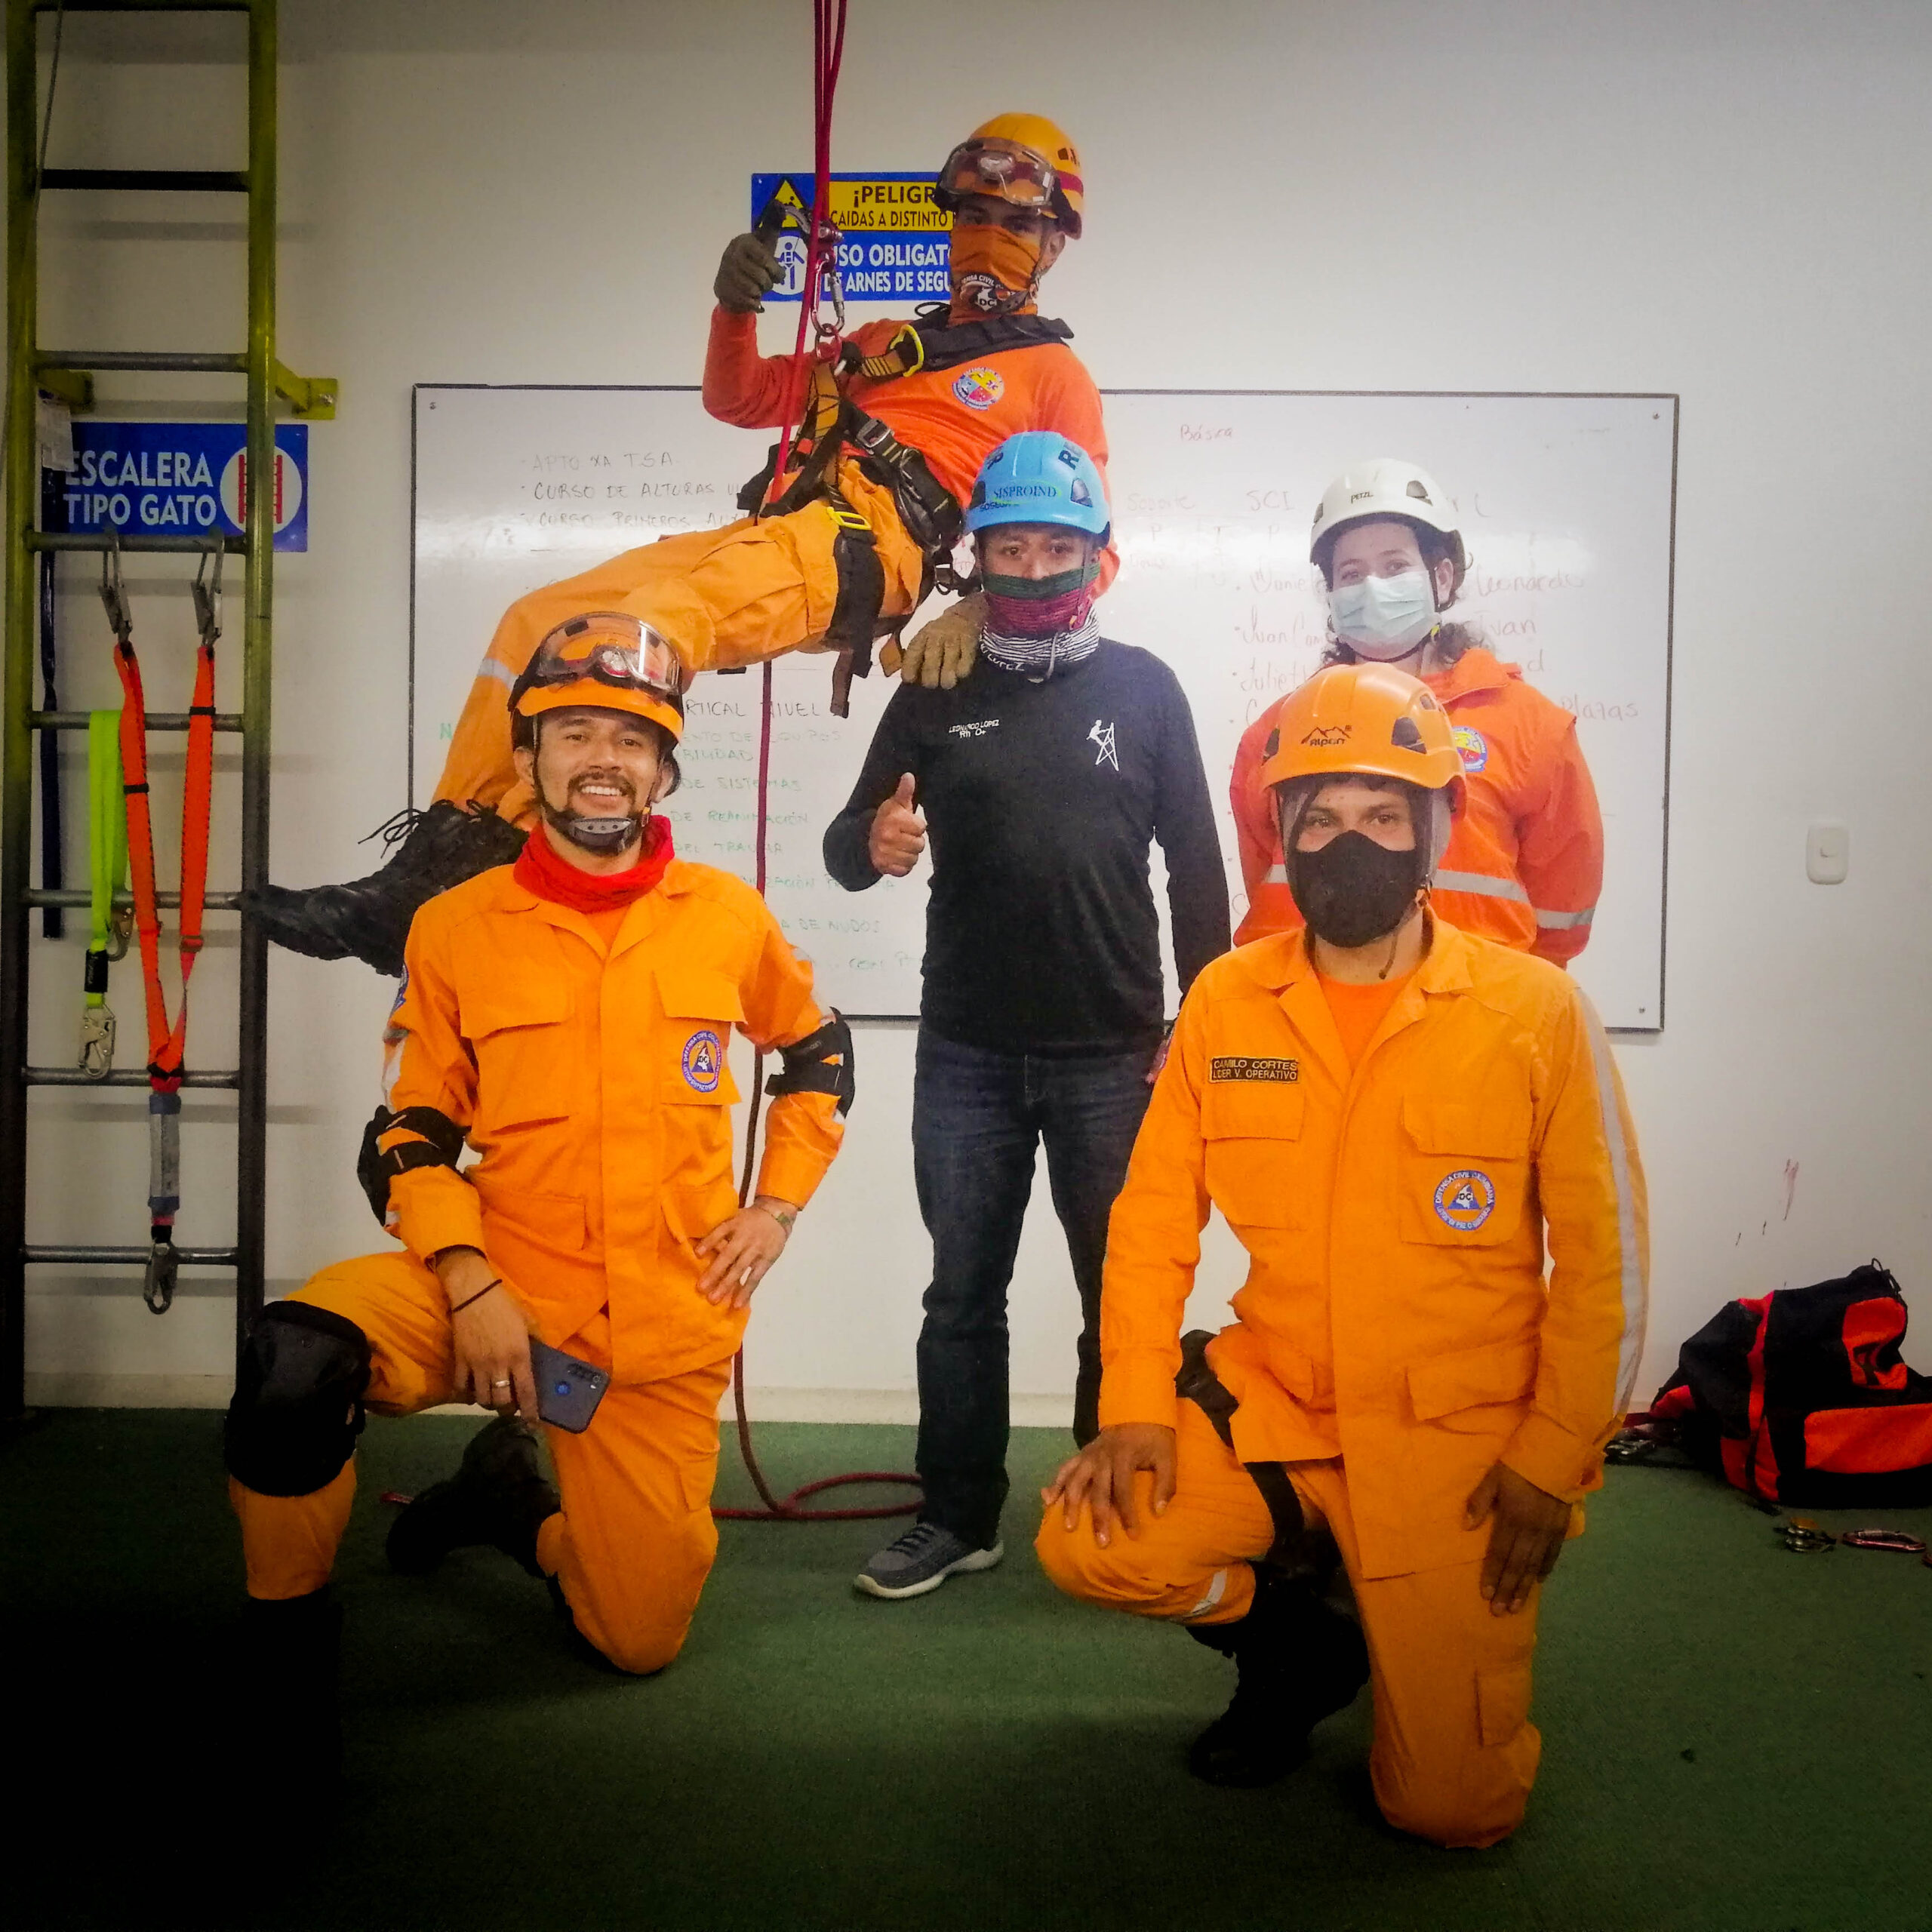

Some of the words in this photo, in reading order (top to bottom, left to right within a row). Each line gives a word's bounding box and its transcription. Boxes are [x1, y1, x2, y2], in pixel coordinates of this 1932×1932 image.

[854, 186, 936, 208] ¡PELIGR
[831, 211, 874, 226] CAIDAS
[878, 211, 886, 226] A
[891, 211, 948, 226] DISTINTO
[869, 244, 951, 266] OBLIGAT
[845, 271, 891, 292] ARNES
[895, 272, 913, 291] DE
[917, 271, 951, 292] SEGU
[65, 451, 214, 488] ESCALERA
[534, 481, 595, 500] CURSO
[607, 485, 626, 498] DE
[641, 481, 715, 498] ALTURAS
[1350, 491, 1374, 503] PETZL
[63, 494, 131, 526] TIPO
[140, 494, 217, 526] GATO
[685, 699, 746, 717] RTICAL
[1214, 1060, 1247, 1069] CAMILO
[1251, 1060, 1298, 1070] CORTES
[1245, 1069, 1297, 1080] OPERATIVO
[1459, 1192, 1472, 1201] DC
